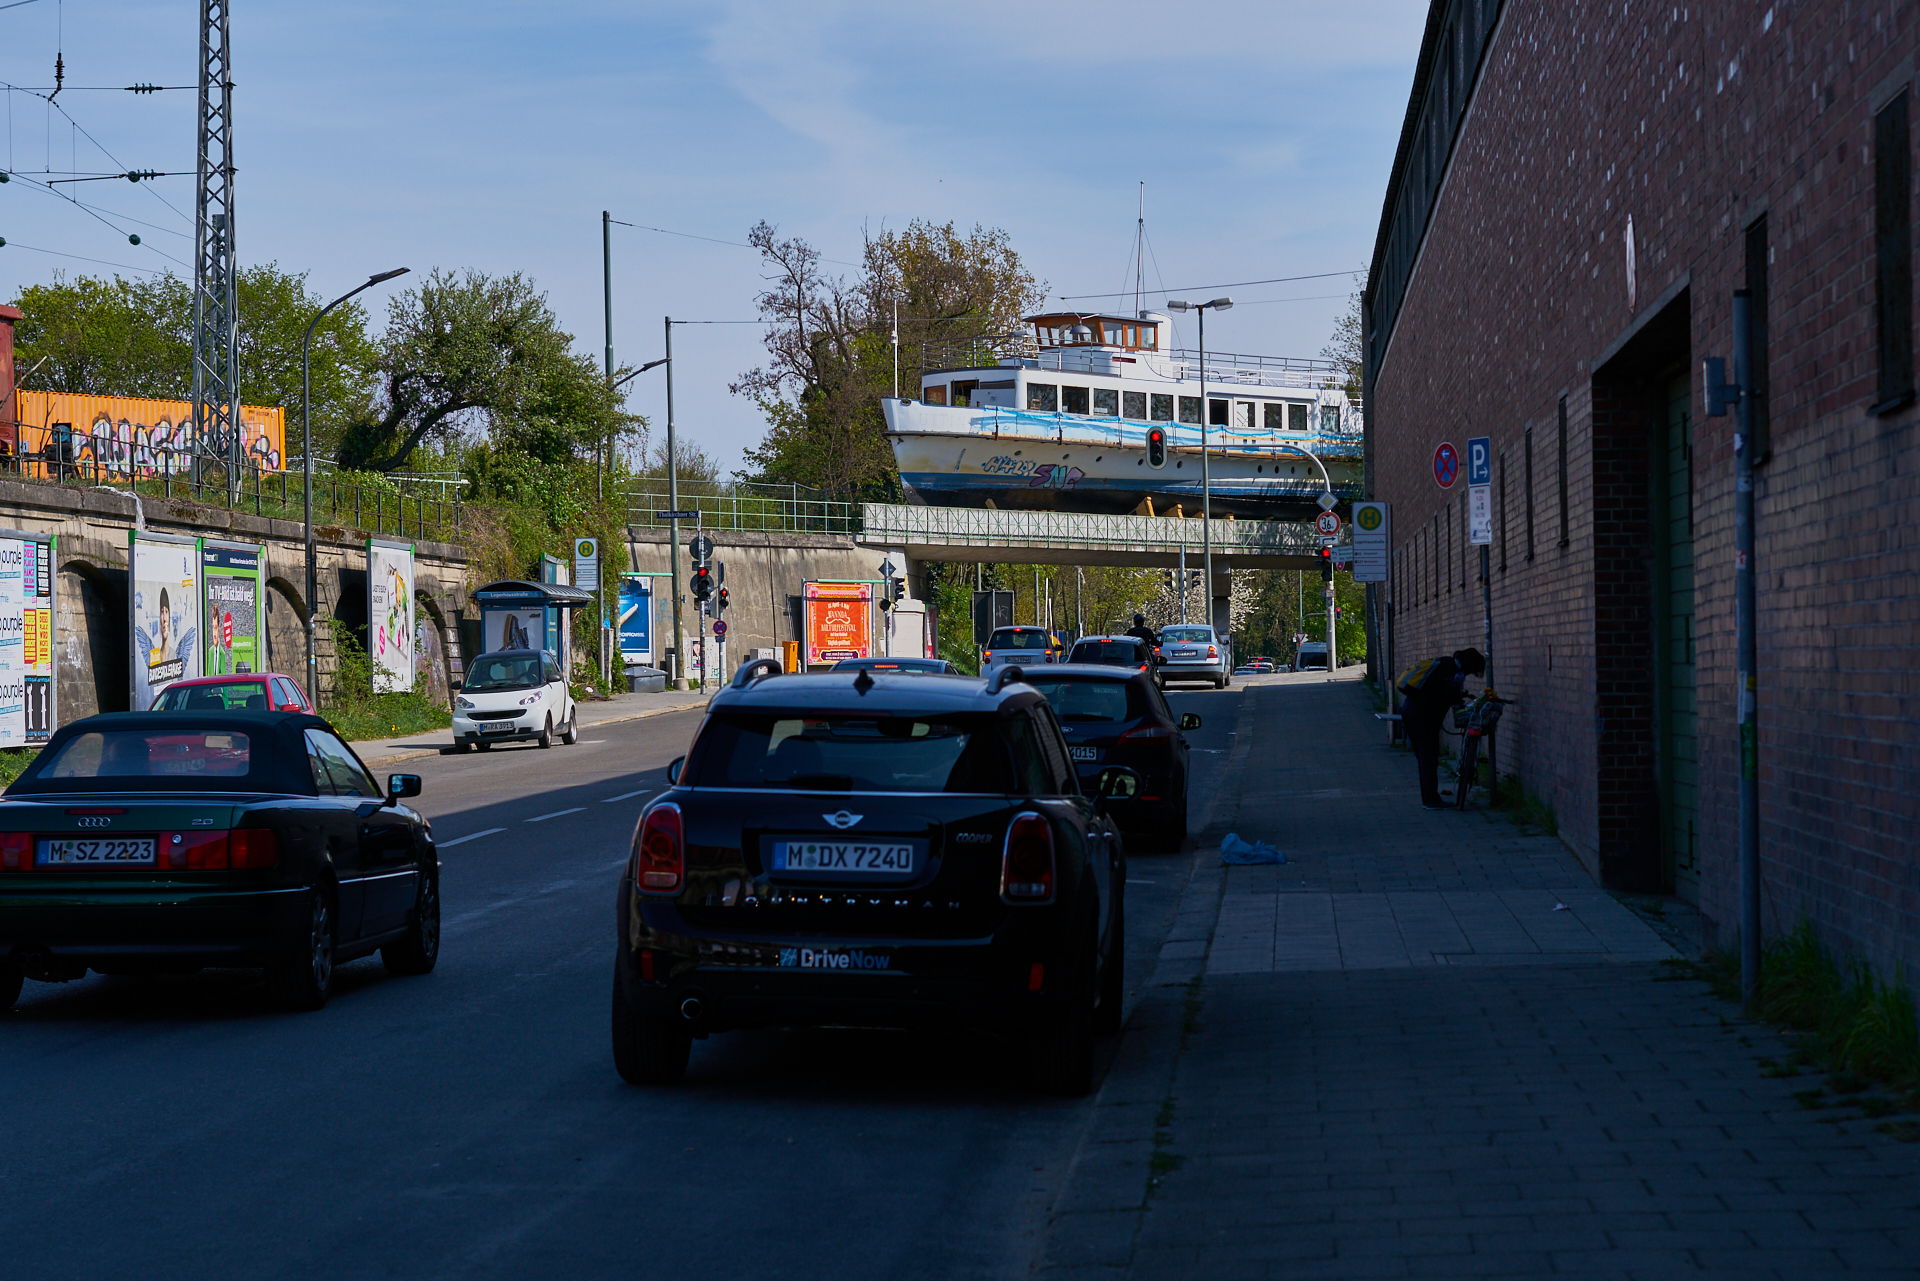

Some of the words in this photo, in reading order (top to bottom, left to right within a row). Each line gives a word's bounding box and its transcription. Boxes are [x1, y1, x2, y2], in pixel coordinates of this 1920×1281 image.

[1364, 512, 1375, 525] H
[582, 545, 590, 553] H
[955, 832, 993, 844] COOPER
[50, 842, 63, 861] M
[76, 842, 100, 861] SZ
[105, 841, 152, 860] 2223
[788, 845, 803, 866] M
[818, 846, 847, 868] DX
[854, 847, 910, 869] 7240
[800, 947, 891, 970] DriveNow
